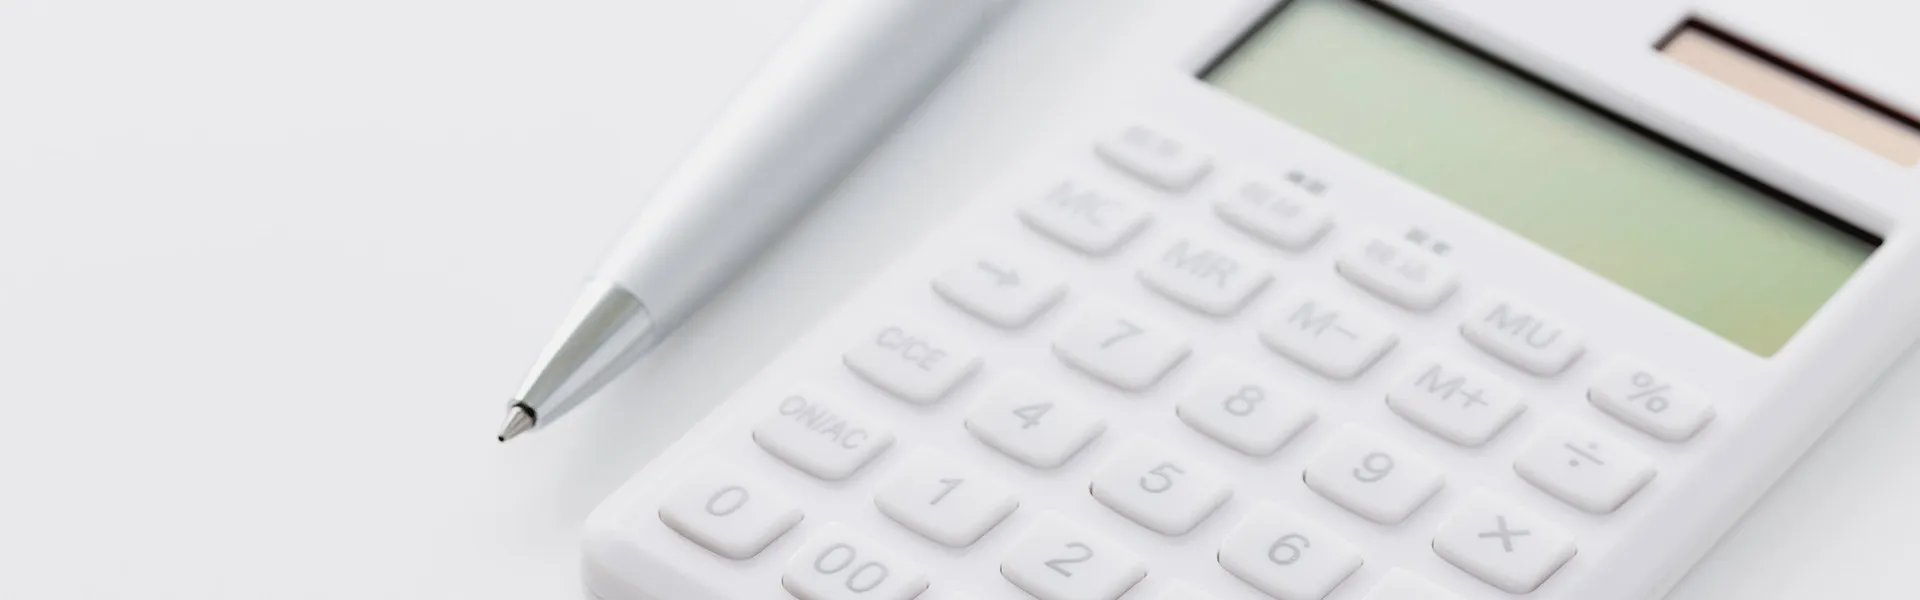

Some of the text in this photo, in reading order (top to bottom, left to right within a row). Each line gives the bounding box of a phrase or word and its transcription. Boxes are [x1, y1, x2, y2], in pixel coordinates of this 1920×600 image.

[1162, 239, 1240, 288] MR
[1100, 319, 1145, 349] 7
[1484, 302, 1563, 349] MU
[1012, 402, 1054, 430] 4
[1222, 384, 1264, 417] 8
[778, 395, 868, 450] ON/AC
[1138, 461, 1185, 494] 5
[1353, 452, 1395, 483] 9
[705, 485, 750, 517] 0
[928, 478, 965, 505] 1
[1043, 541, 1094, 578] 2
[1267, 532, 1311, 566] 6
[813, 542, 889, 594] 00
